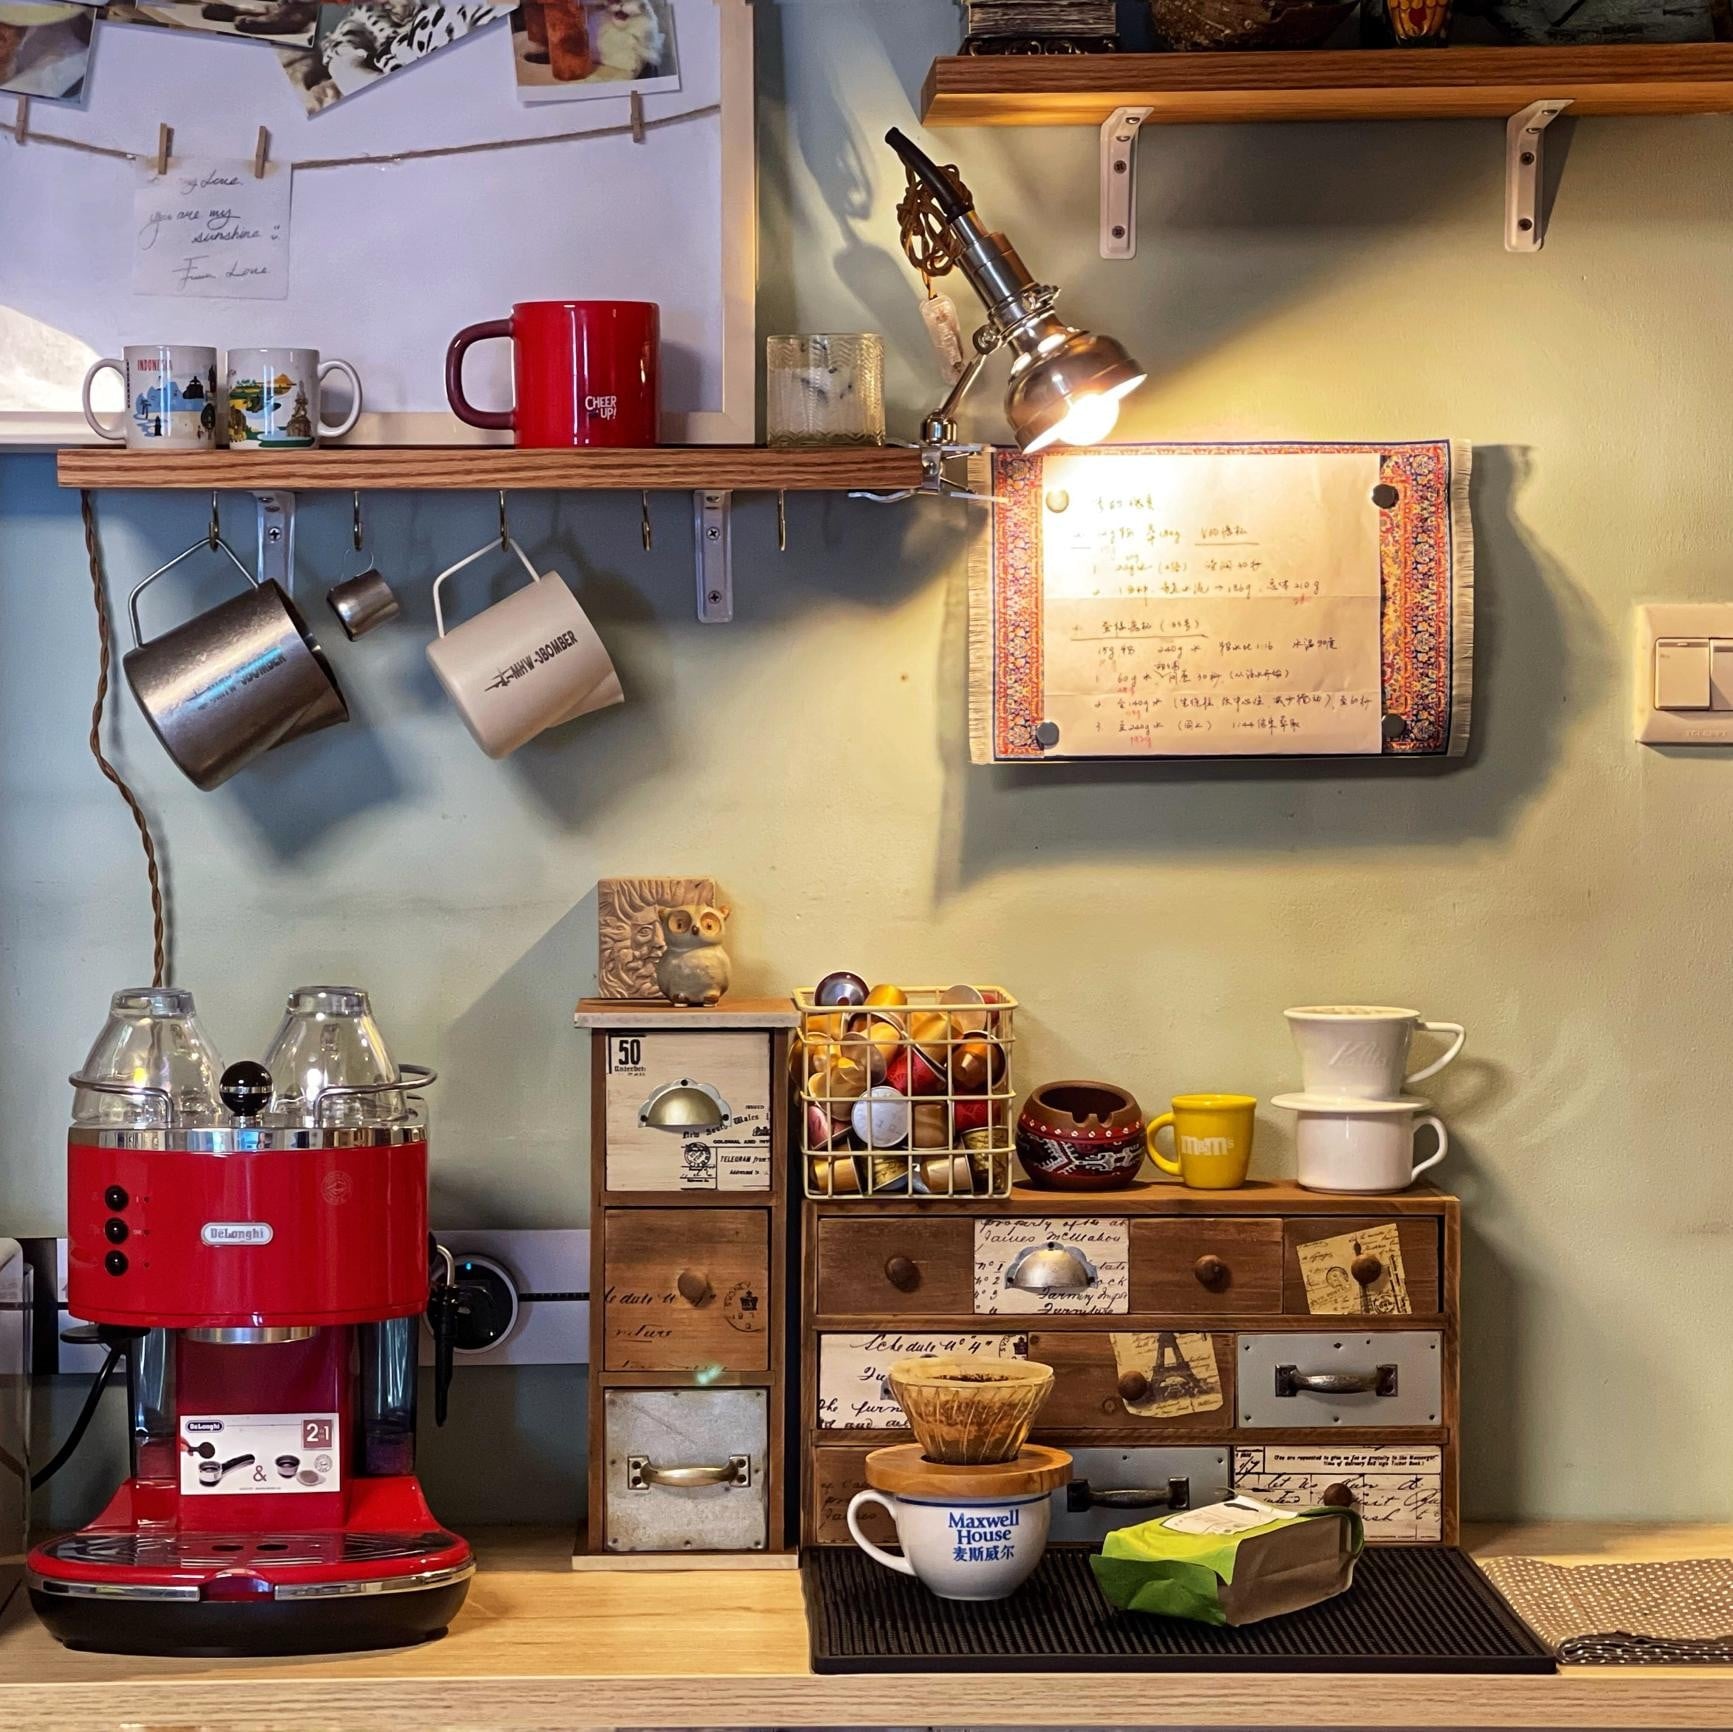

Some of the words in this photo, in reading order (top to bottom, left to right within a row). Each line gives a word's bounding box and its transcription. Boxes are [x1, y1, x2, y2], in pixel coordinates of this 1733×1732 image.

[177, 209, 200, 220] are
[207, 208, 240, 231] my
[191, 225, 261, 244] sunshine
[585, 395, 617, 411] CHEER
[600, 407, 617, 420] UP!
[510, 630, 578, 680] MHW-3BOMBER
[618, 1039, 641, 1066] 50
[210, 1228, 264, 1241] DeLonghi
[979, 1229, 1036, 1247] James
[306, 1423, 319, 1442] 2
[253, 1464, 267, 1482] &
[948, 1509, 1020, 1529] Maxwell
[956, 1529, 1012, 1545] House
[952, 1545, 1016, 1562] 麦斯威尔
